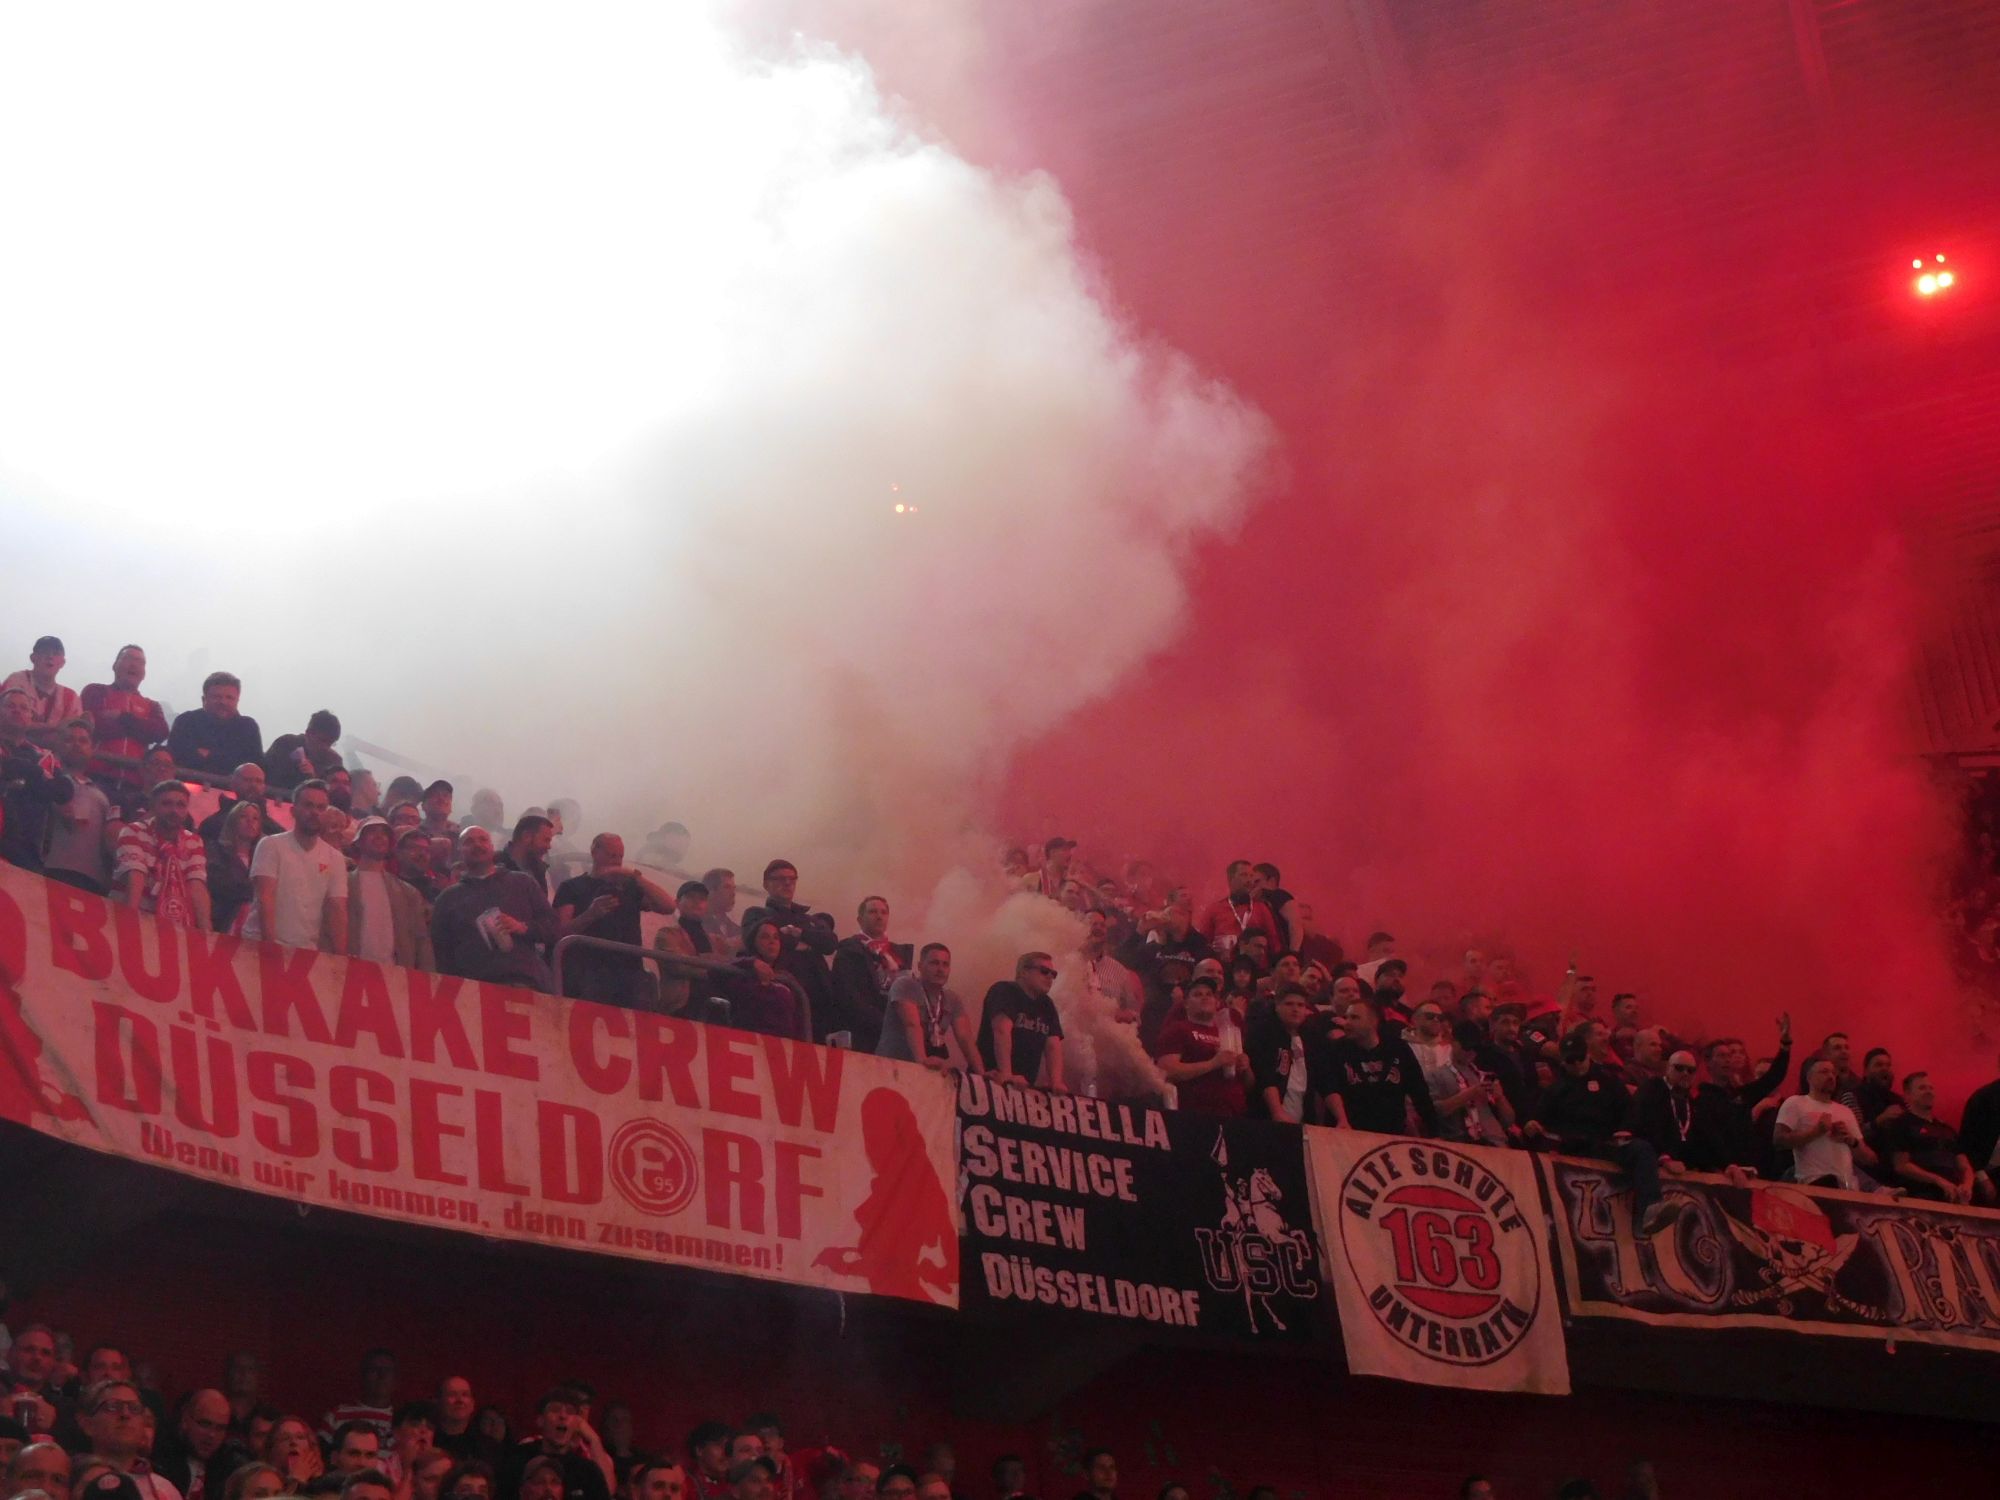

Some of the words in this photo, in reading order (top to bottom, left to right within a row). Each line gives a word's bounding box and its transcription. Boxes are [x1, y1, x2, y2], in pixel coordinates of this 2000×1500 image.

[45, 877, 540, 1083] BUKKAKE
[568, 999, 844, 1134] CREW
[959, 1071, 1171, 1151] UMBRELLA
[140, 1121, 240, 1177] Wenn
[254, 1160, 315, 1192] wir
[503, 1200, 586, 1241] dann
[597, 1222, 784, 1271] zusammen!
[963, 1124, 1138, 1202] SERVICE
[1345, 1151, 1402, 1220] ALTE
[1408, 1147, 1522, 1233] SCHULE
[970, 1183, 1086, 1251] CREW
[1378, 1207, 1501, 1291] 163
[981, 1251, 1200, 1327] DÜSSELDORF
[1194, 1226, 1318, 1299] USC
[1369, 1285, 1530, 1358] UNTERRATH
